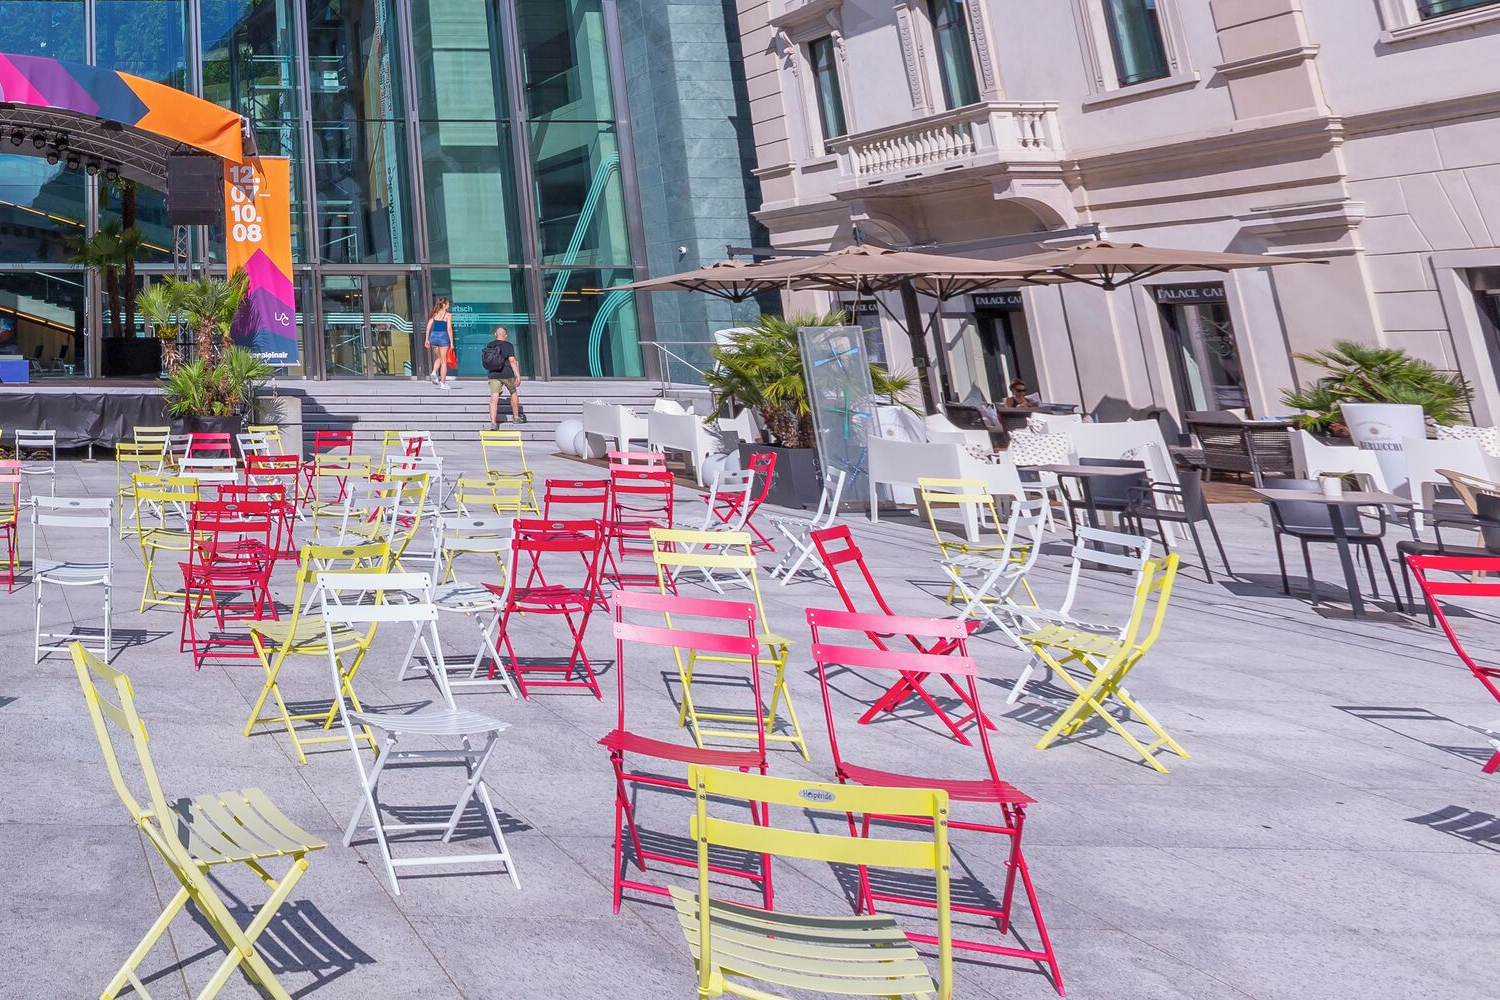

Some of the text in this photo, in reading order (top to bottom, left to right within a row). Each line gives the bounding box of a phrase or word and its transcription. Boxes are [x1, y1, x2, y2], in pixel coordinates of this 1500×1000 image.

[229, 165, 261, 184] 12.
[231, 204, 262, 223] 10.
[232, 223, 263, 242] 08
